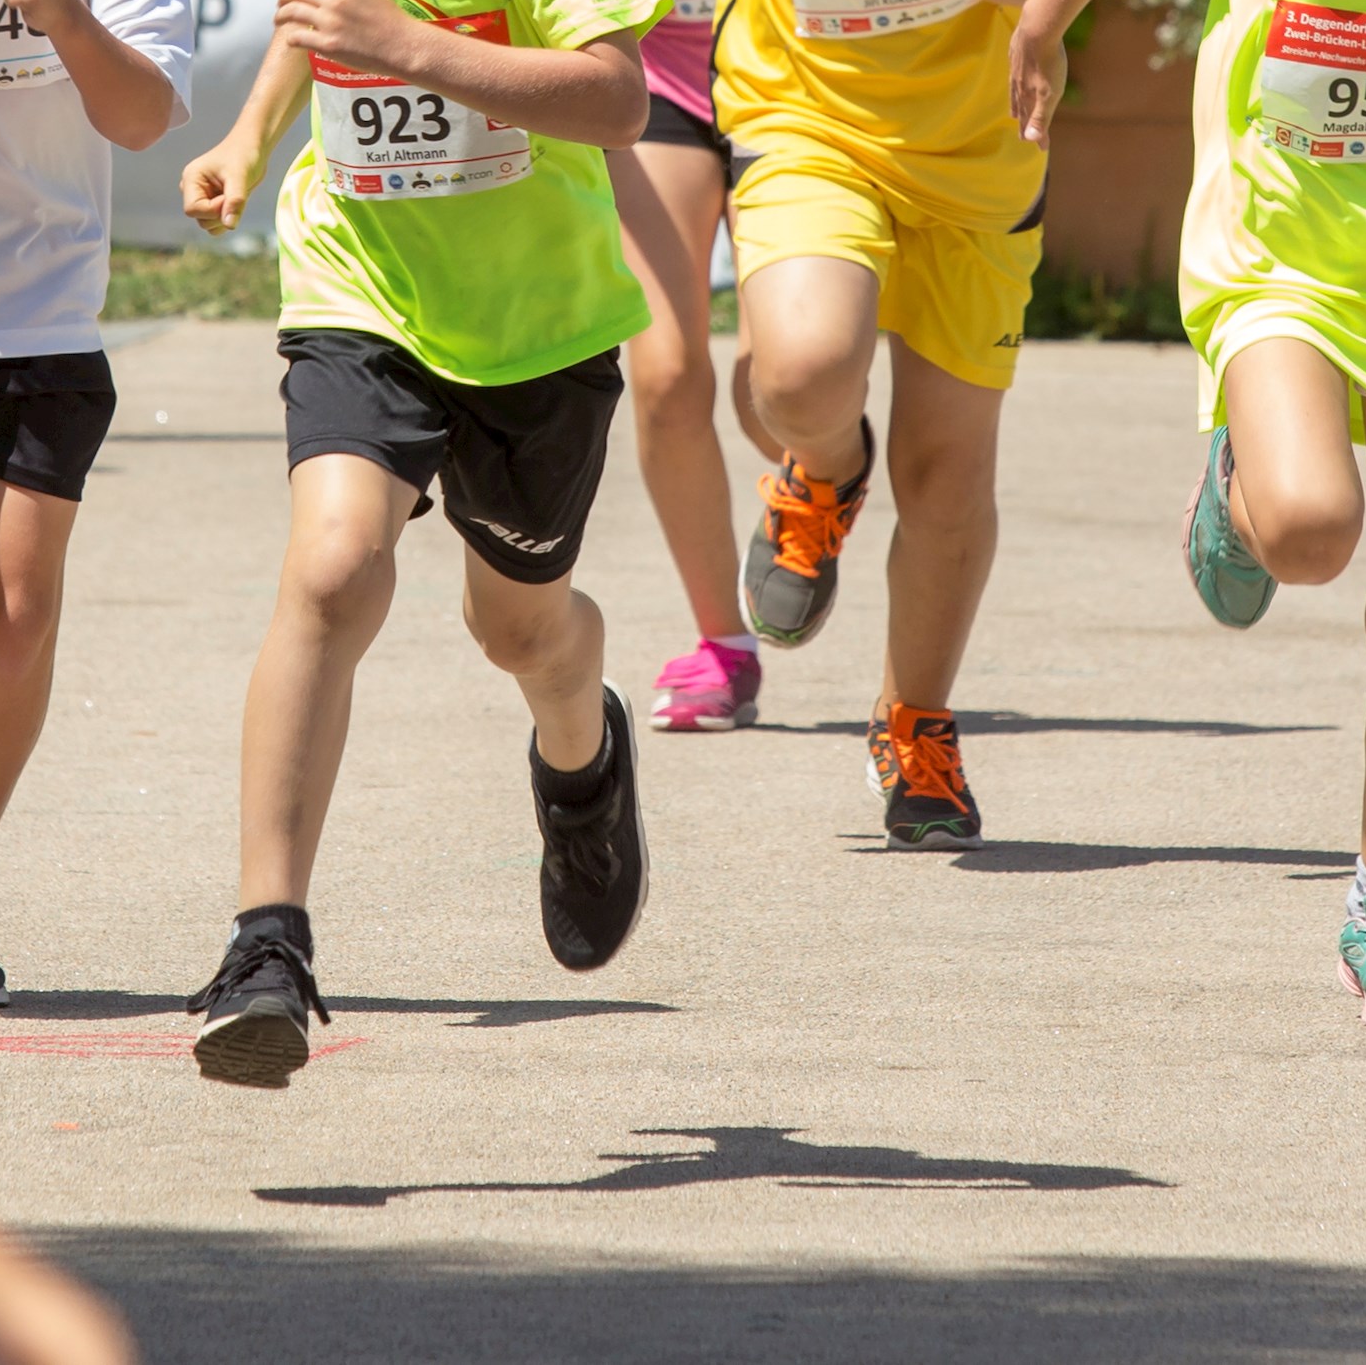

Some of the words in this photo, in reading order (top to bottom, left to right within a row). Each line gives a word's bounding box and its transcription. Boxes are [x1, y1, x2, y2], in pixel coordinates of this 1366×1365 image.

[1287, 10, 1298, 24] 3.
[351, 93, 451, 146] 923
[366, 151, 390, 163] Karl
[394, 148, 447, 162] Altmann
